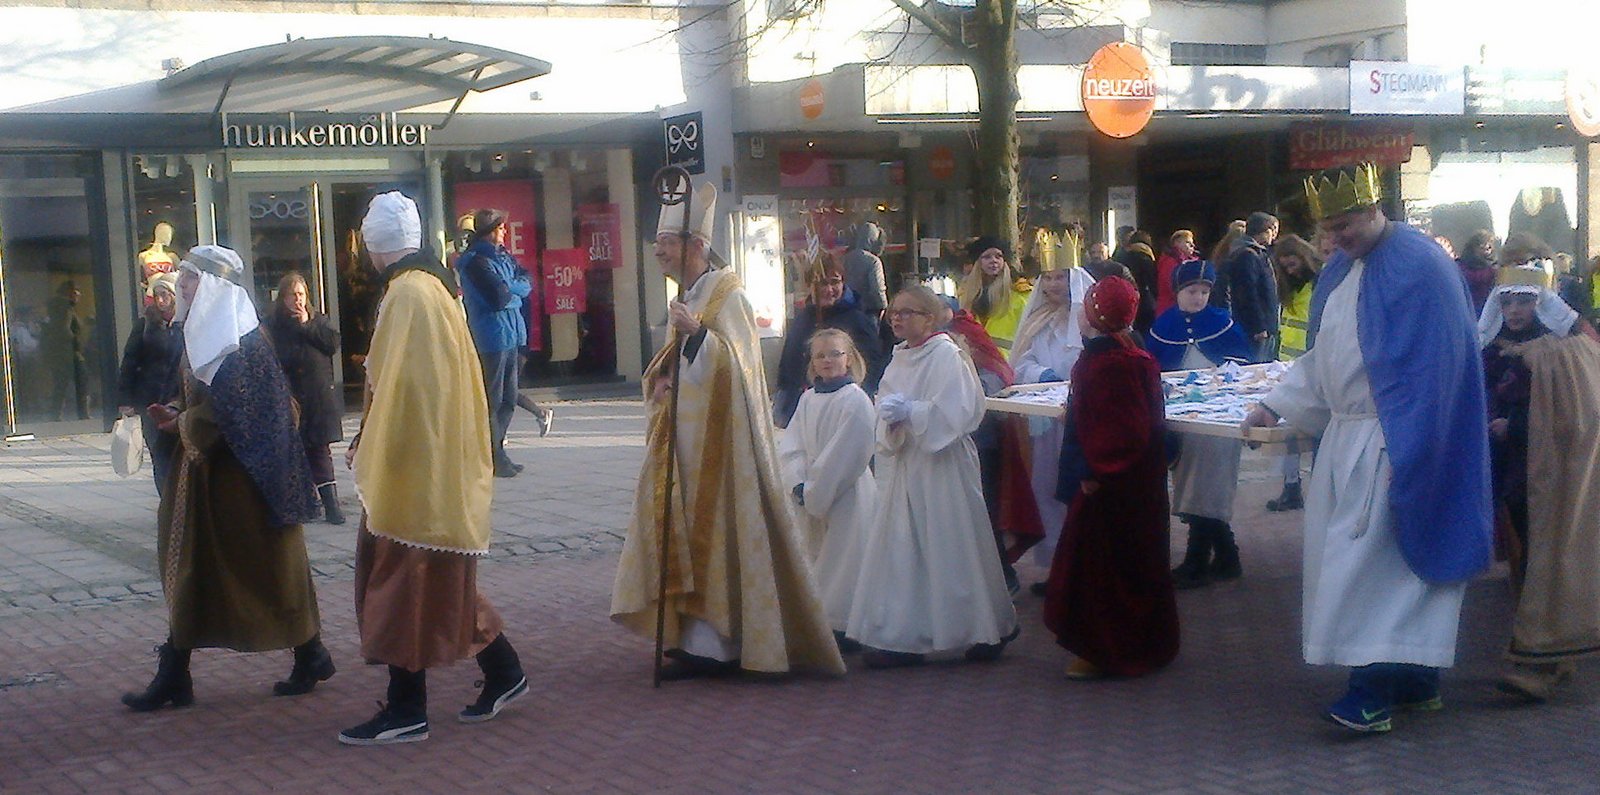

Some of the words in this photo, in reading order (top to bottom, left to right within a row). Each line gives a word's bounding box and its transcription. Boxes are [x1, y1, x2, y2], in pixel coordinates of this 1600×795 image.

[1085, 76, 1154, 96] neuzeit
[1370, 70, 1448, 94] STEGMANN
[221, 111, 433, 147] hunkemöller
[746, 201, 773, 211] ONLY
[589, 247, 613, 261] SALE
[547, 265, 583, 287] -50%
[556, 298, 575, 310] SALE
